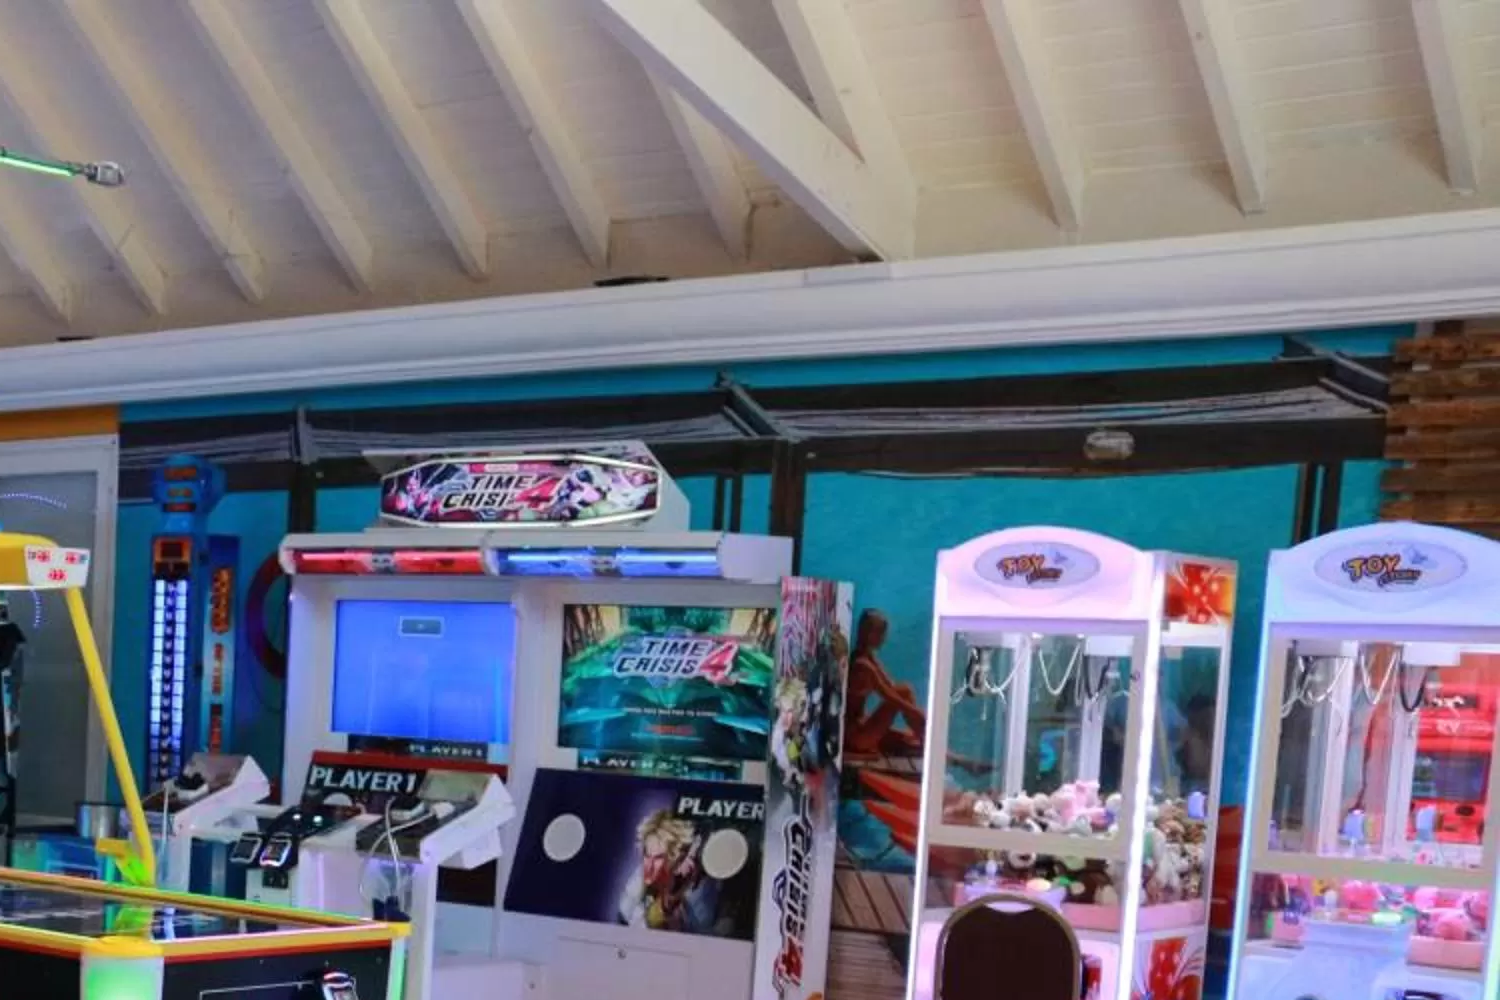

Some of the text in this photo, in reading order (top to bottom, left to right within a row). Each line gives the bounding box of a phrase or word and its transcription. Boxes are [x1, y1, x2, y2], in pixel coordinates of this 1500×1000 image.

[469, 475, 529, 490] TIME
[514, 478, 560, 508] 4
[1342, 553, 1401, 582] TOY
[616, 641, 736, 680] CRISIS 4
[644, 640, 707, 656] TIME
[309, 765, 417, 793] PLAYER 1
[678, 796, 765, 819] PLAYER
